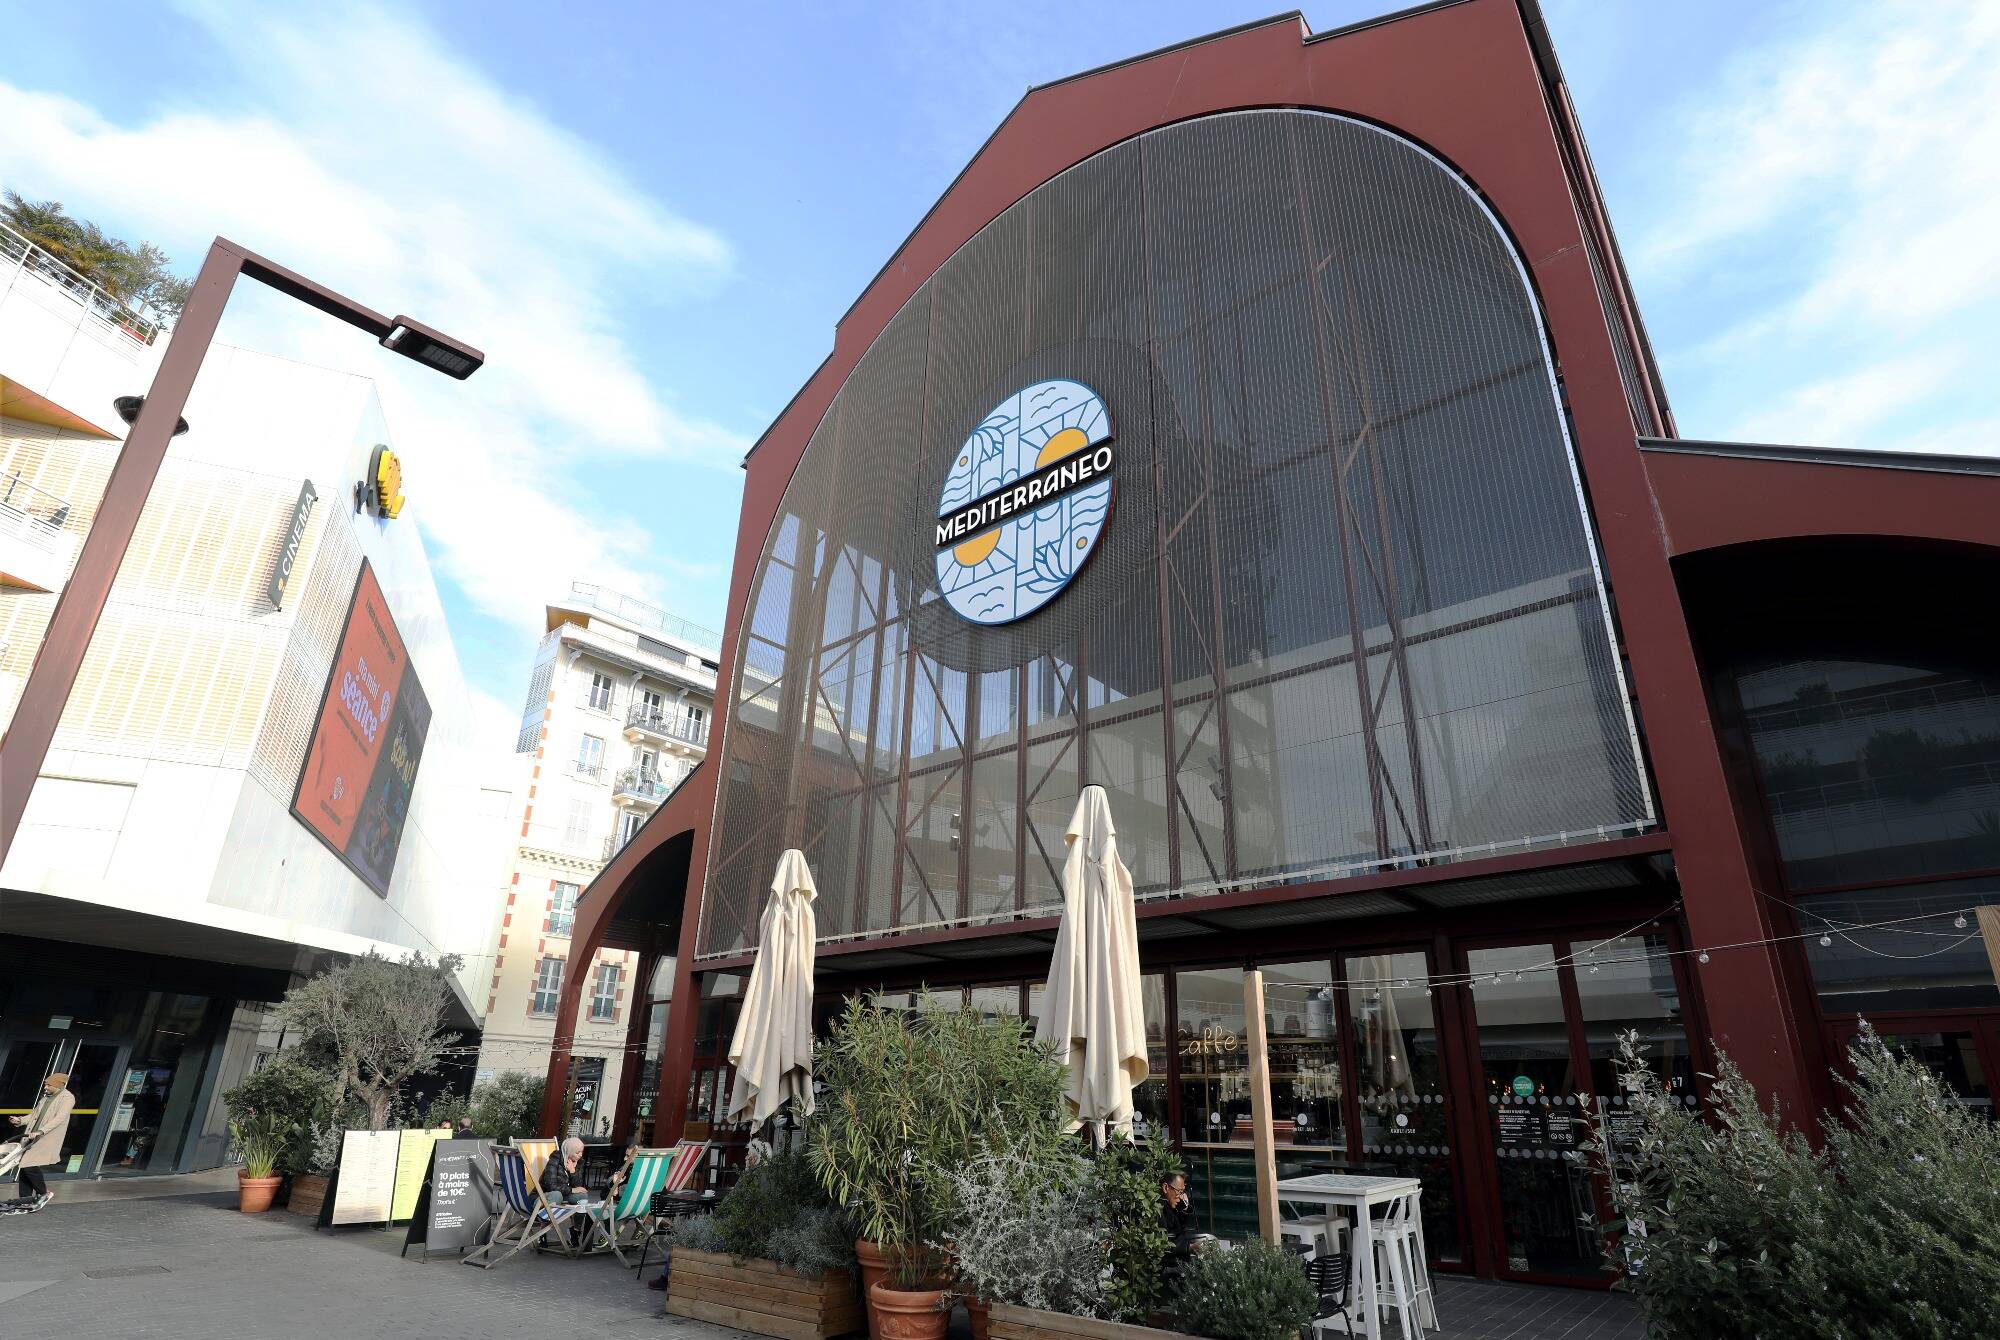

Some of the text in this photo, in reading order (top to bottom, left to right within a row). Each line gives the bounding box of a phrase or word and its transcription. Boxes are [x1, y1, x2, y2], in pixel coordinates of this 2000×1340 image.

[936, 446, 1112, 546] MEDITERRANEO
[282, 492, 315, 576] CINEMA
[340, 671, 378, 743] séance
[437, 1189, 448, 1197] de
[439, 1172, 470, 1182] 10 plats
